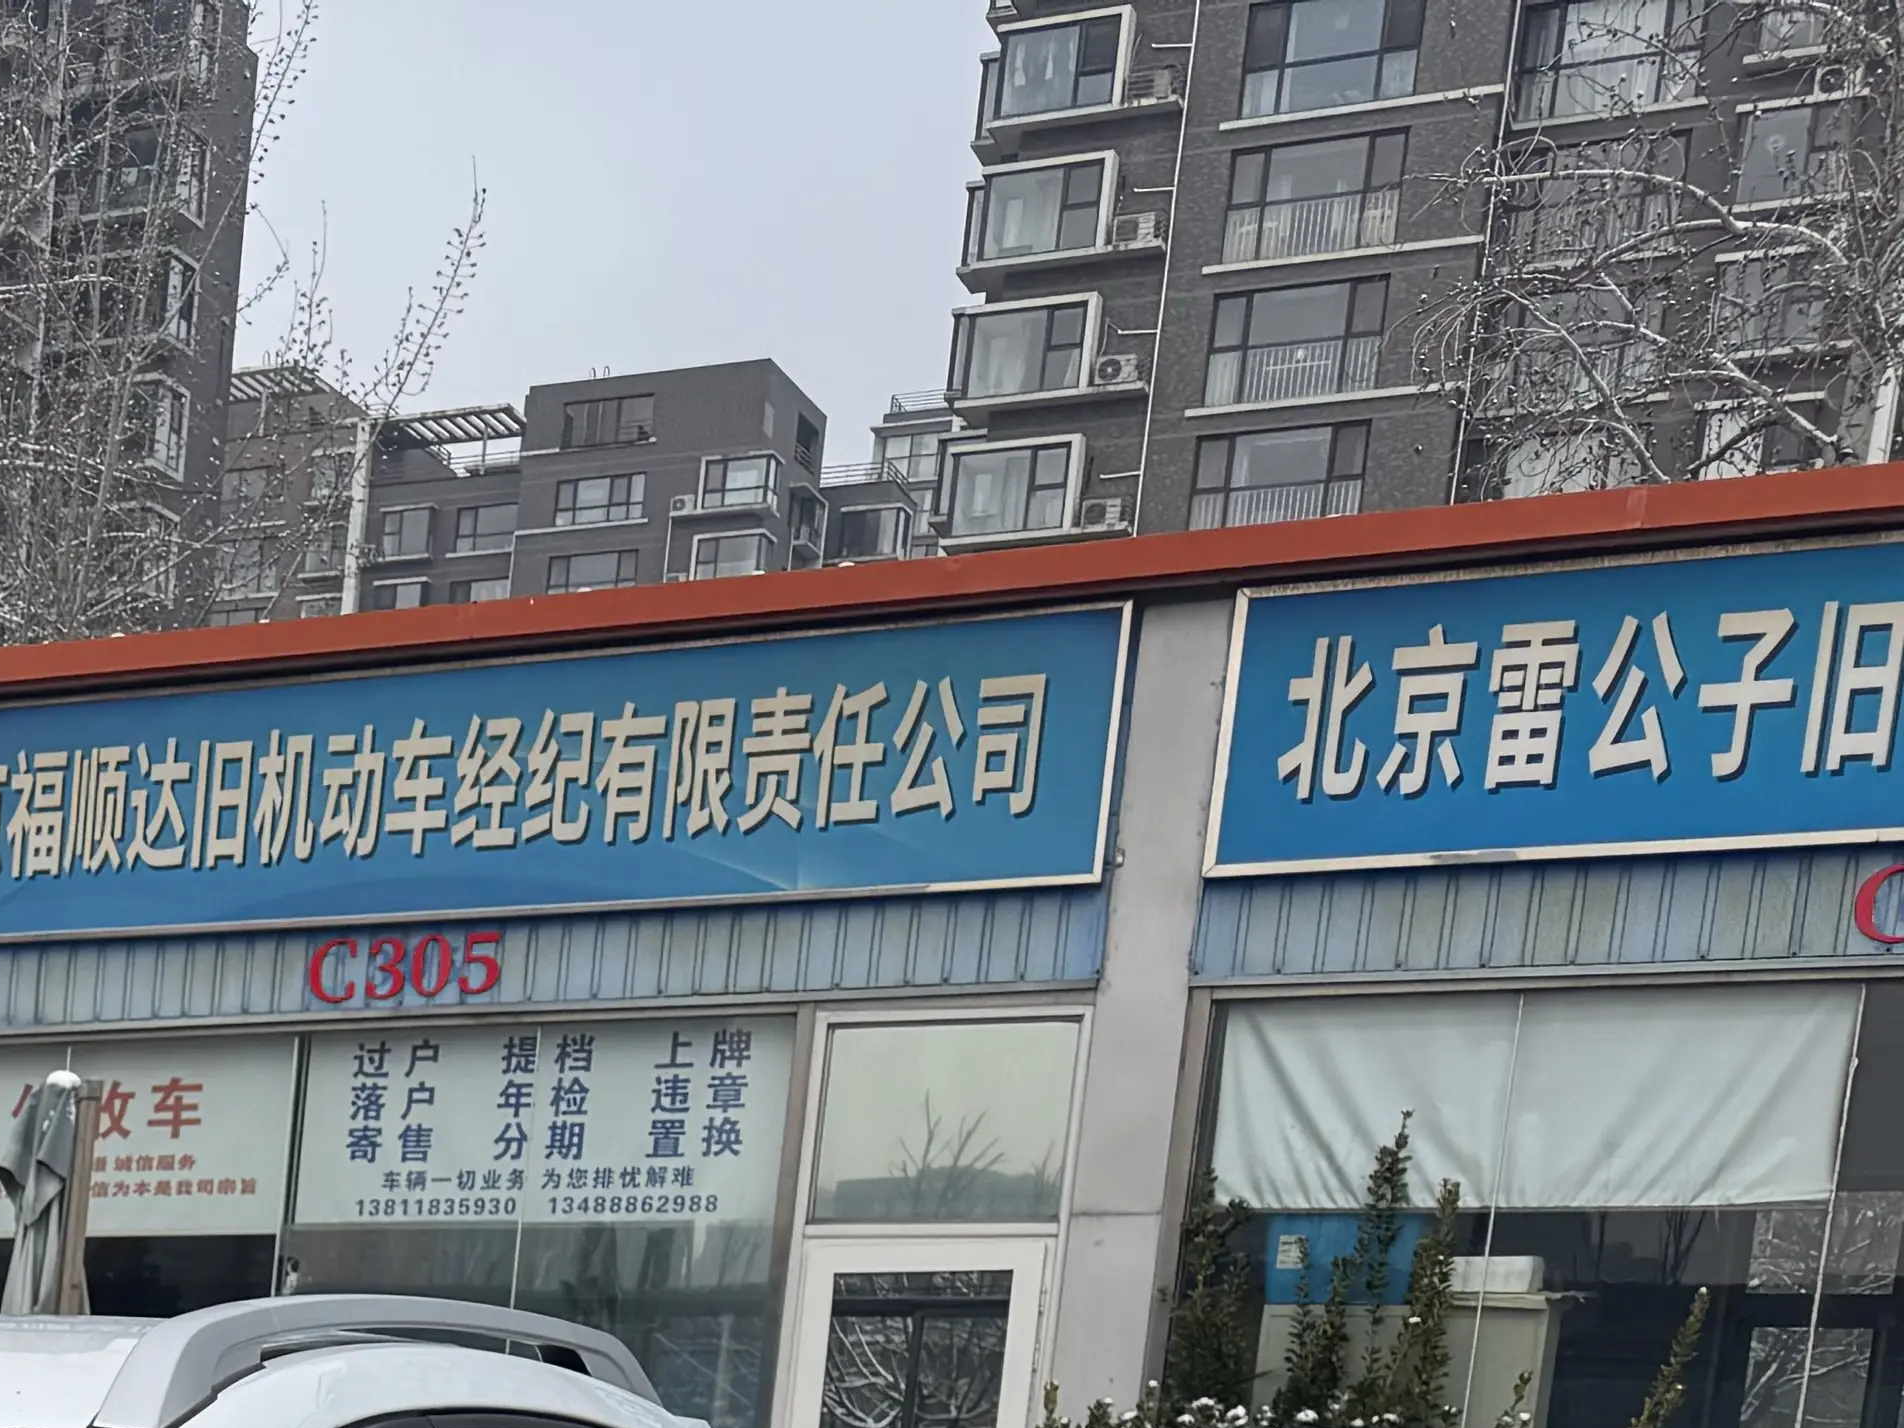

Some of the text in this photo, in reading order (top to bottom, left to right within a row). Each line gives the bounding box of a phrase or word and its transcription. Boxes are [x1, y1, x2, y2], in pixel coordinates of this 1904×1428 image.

[1278, 601, 1904, 799] 北京雷公子旧
[309, 932, 501, 1003] C305
[352, 1028, 752, 1079] 过户 提档 上牌
[349, 1072, 749, 1122] 落户 年检 违章
[346, 1116, 744, 1163] 寄售 分期 置换
[382, 1165, 695, 1192] 车辆一切业务 为您排忧解难
[355, 1194, 719, 1217] 13811835930 13488862988
